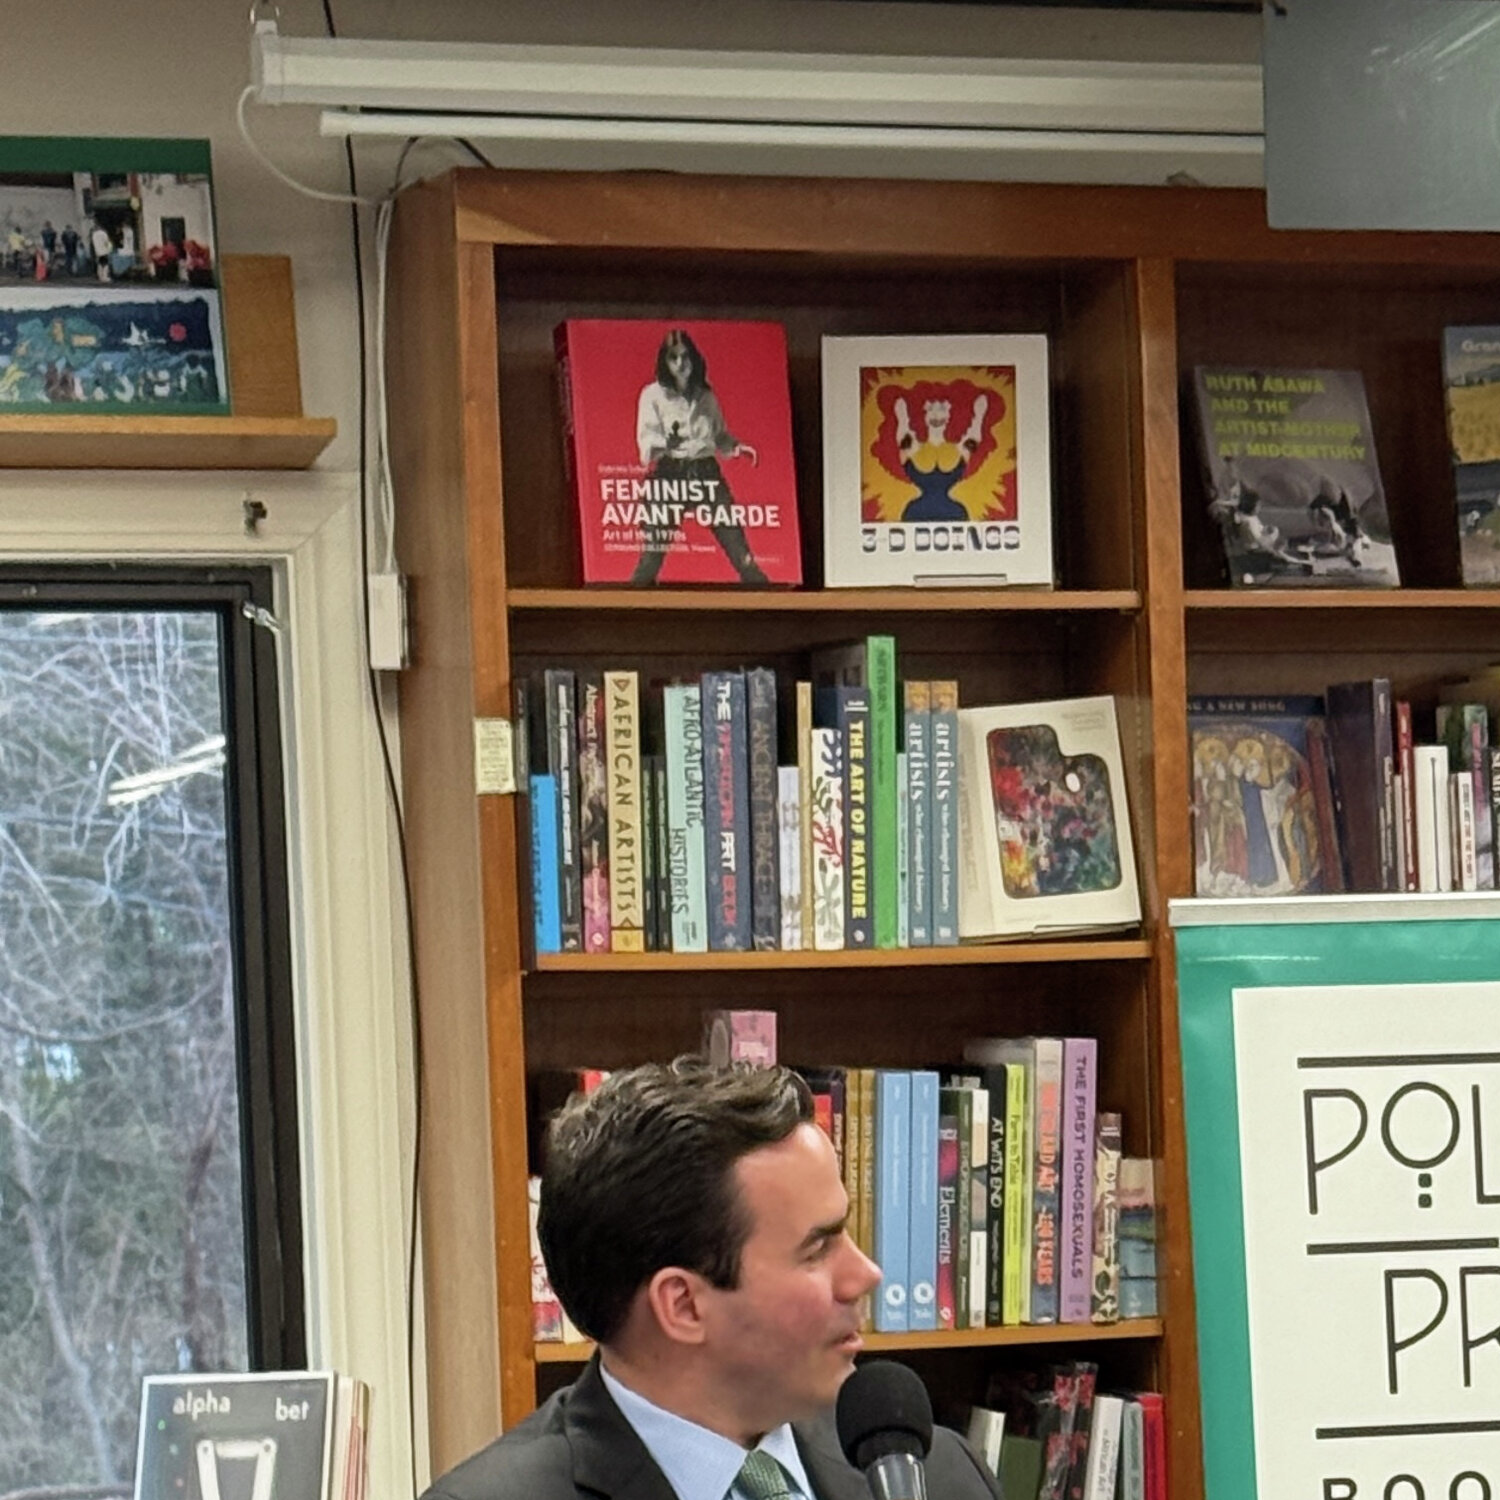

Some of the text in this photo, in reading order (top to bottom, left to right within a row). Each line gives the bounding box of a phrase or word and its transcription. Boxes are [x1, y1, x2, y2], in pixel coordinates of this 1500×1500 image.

[1206, 374, 1257, 392] RUTH
[1211, 398, 1290, 414] AND THE
[1219, 440, 1241, 457] AT
[600, 479, 720, 502] FEMINIST
[602, 503, 781, 527] AVANT-GARDE
[914, 526, 1021, 552] DOINGS
[716, 681, 732, 721] THE
[683, 695, 706, 830] AFRO-ATLANTIC
[908, 722, 927, 801] artists
[935, 722, 955, 801] artists
[613, 696, 637, 914] AFRICAN ARTISTS
[753, 719, 776, 885] ANCIENT THRACE
[847, 719, 868, 920] THE ART OF NATURE
[670, 827, 690, 915] HISTORIES
[720, 831, 736, 872] ART
[1009, 1114, 1022, 1143] Farm
[989, 1116, 1004, 1208] AT END
[1008, 1156, 1021, 1186] Table
[1038, 1165, 1057, 1193] ART
[1071, 1055, 1088, 1279] THE FIRST HOMOSEXUALS
[939, 1186, 956, 1265] Elements
[1037, 1240, 1055, 1285] YEARS
[172, 1388, 310, 1423] alpha bet
